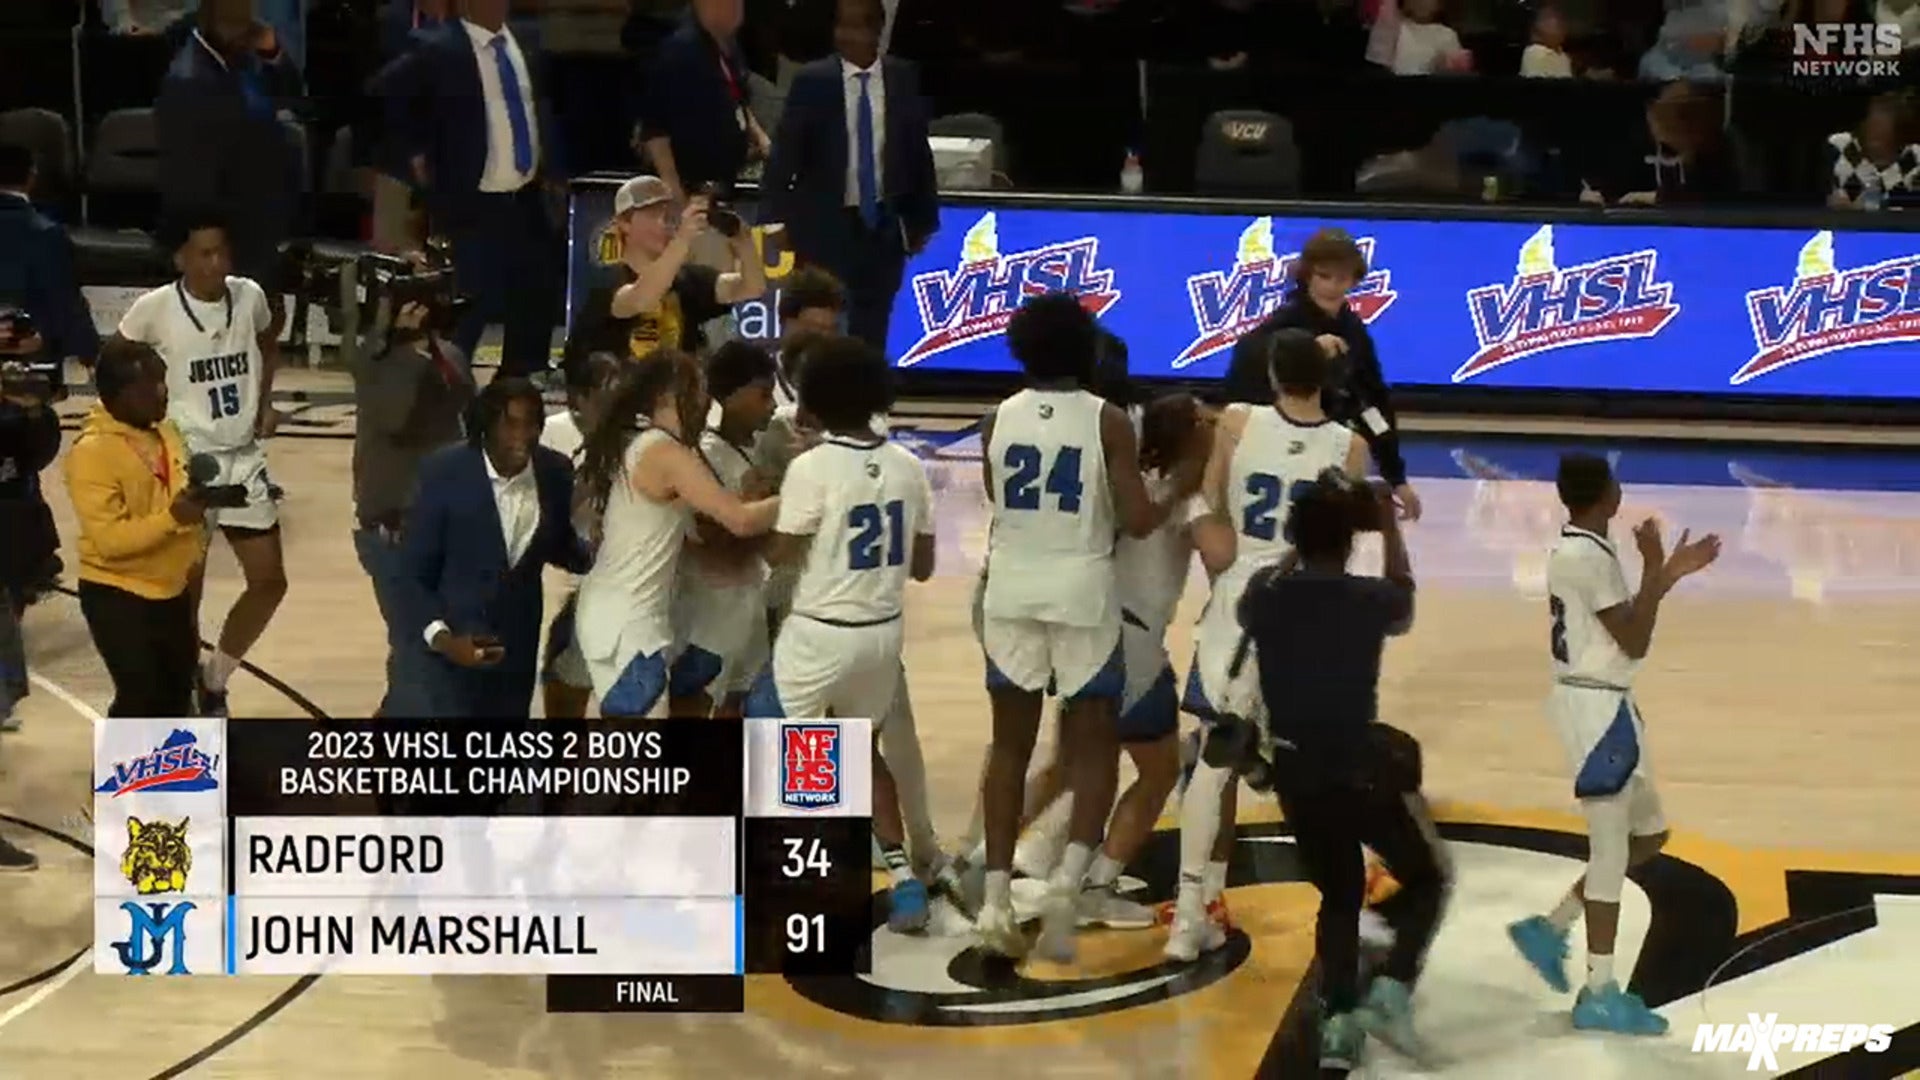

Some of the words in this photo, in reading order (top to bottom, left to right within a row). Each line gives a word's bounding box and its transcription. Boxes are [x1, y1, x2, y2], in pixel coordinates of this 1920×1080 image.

[1231, 121, 1267, 139] VCU
[913, 238, 1114, 333] VHSL
[1467, 249, 1673, 347] VHSL
[189, 352, 249, 383] JUSTICES
[208, 384, 240, 420] 15
[1003, 443, 1084, 514] 24
[848, 500, 904, 570] 21
